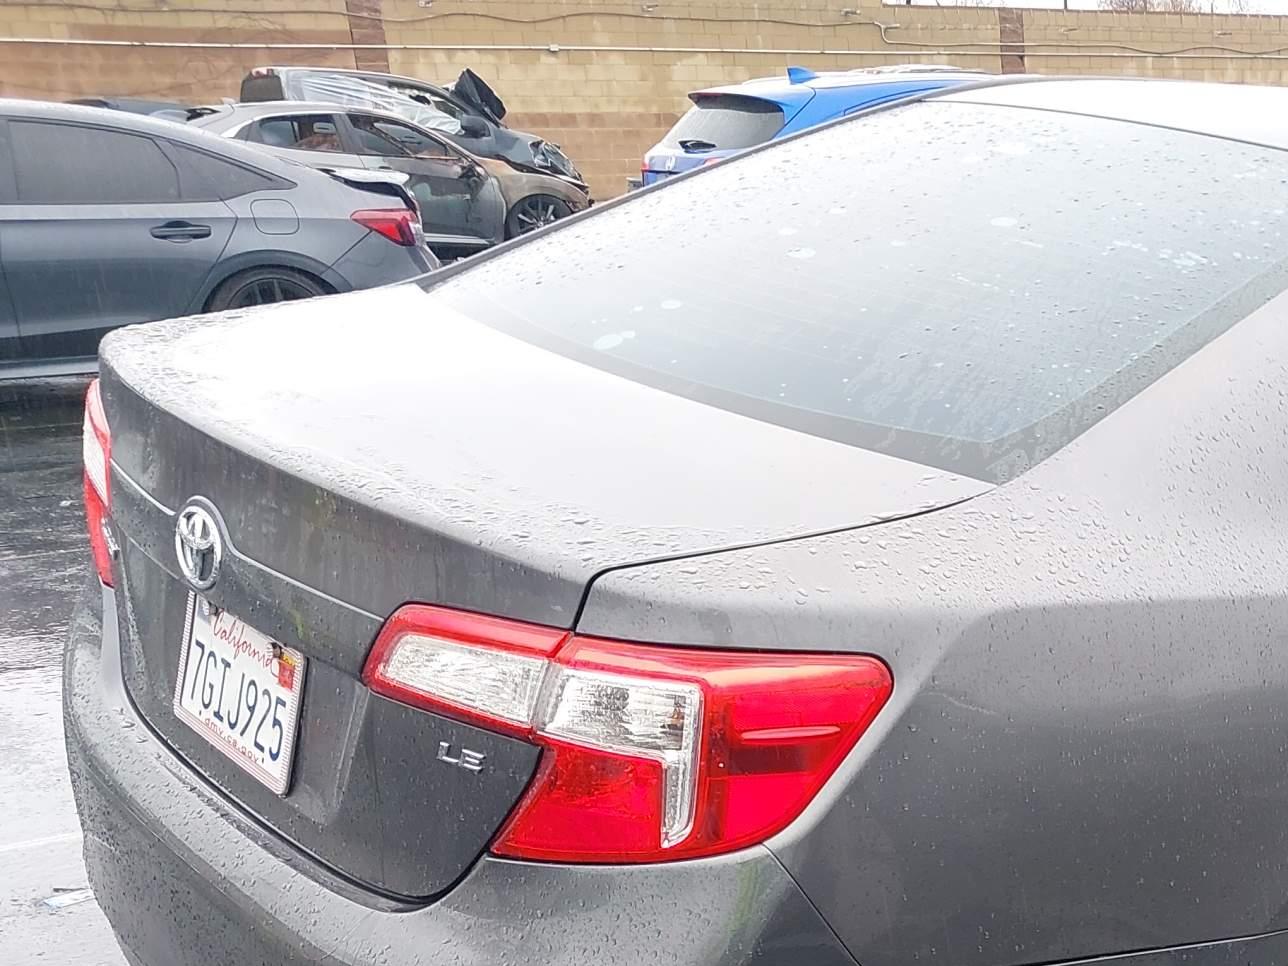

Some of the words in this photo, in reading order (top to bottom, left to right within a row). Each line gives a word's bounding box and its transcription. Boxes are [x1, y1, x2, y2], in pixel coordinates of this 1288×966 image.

[212, 607, 276, 669] California
[191, 639, 287, 762] 7GIJ925
[204, 716, 260, 763] dmv.ca.gov
[436, 741, 485, 774] LE
